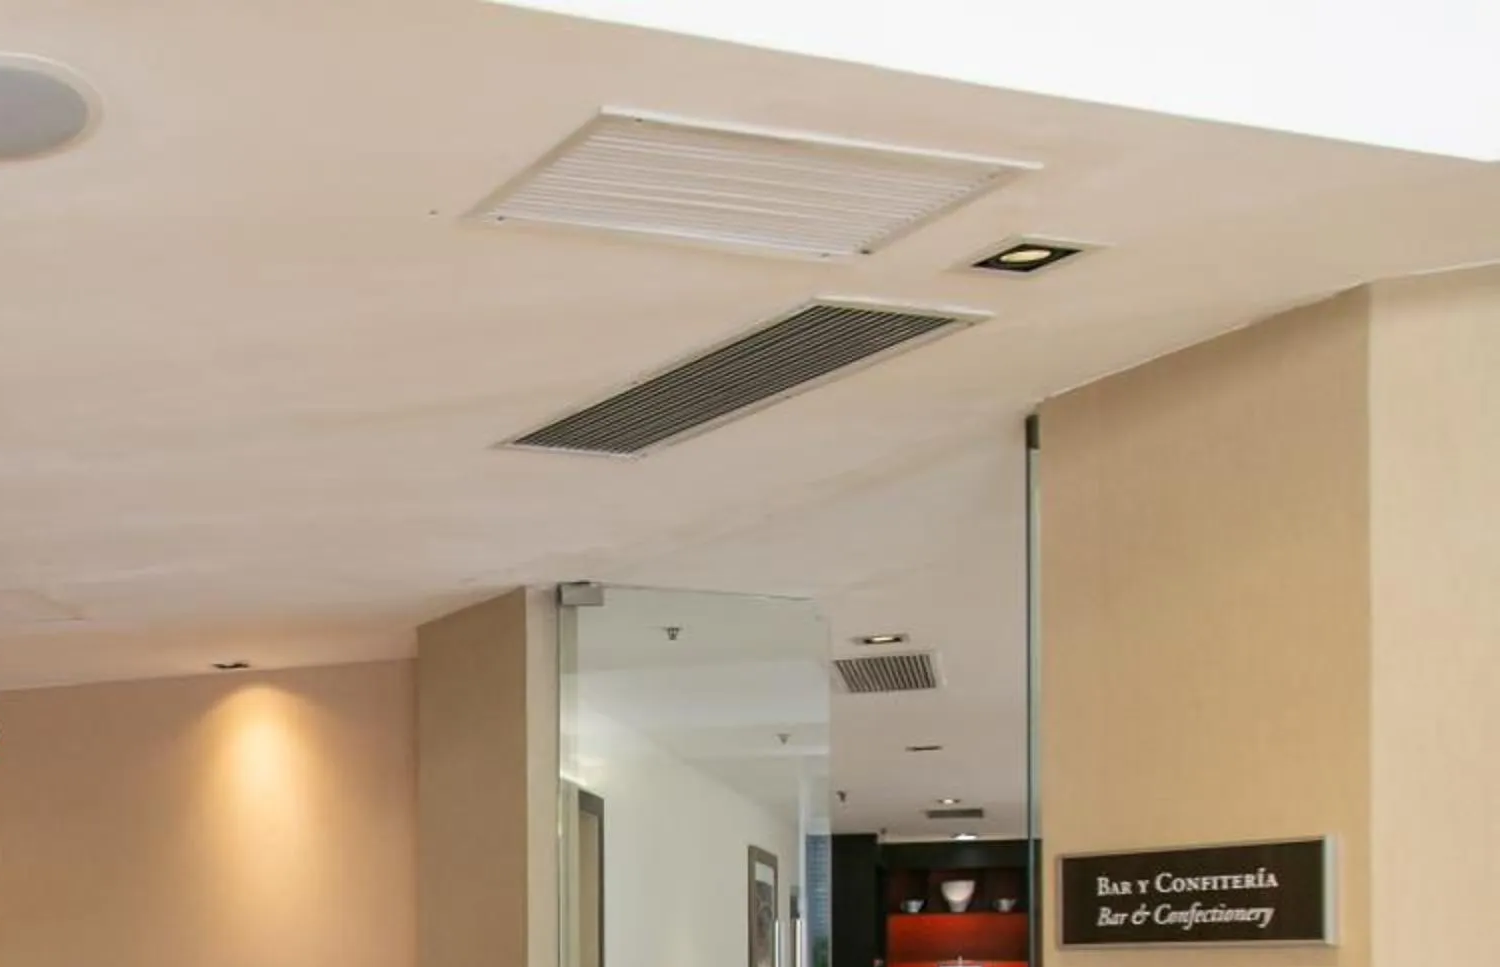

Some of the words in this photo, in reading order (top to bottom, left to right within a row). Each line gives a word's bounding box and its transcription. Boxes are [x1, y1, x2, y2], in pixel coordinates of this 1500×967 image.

[1096, 876, 1132, 896] BAR
[1137, 879, 1150, 894] Y
[1155, 867, 1279, 893] CONFITERÍA
[1097, 906, 1129, 926] Bar
[1131, 903, 1151, 925] &
[1154, 902, 1275, 931] Confectionery
